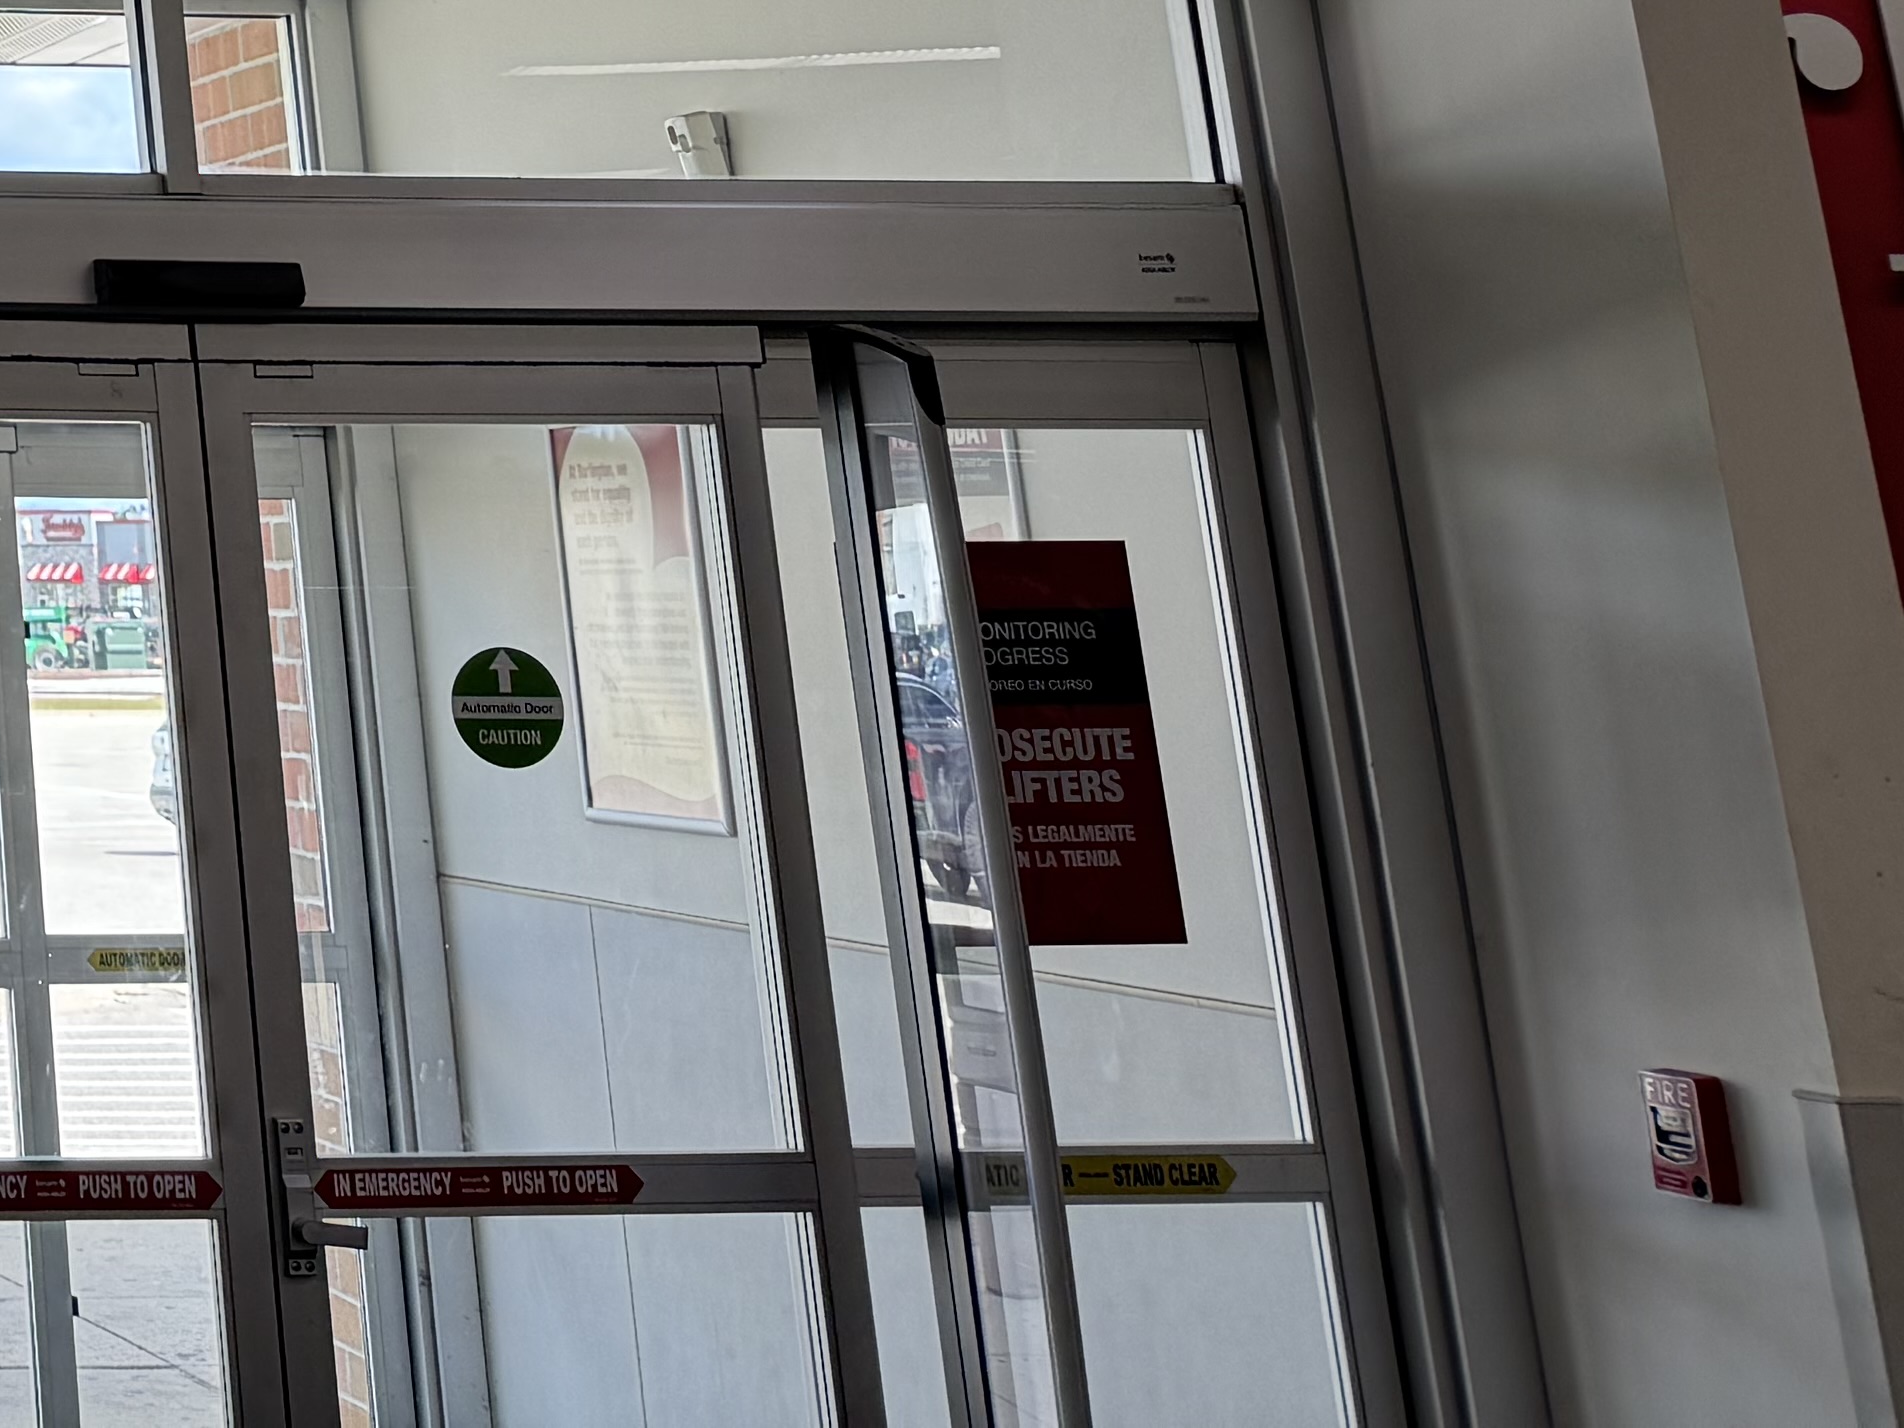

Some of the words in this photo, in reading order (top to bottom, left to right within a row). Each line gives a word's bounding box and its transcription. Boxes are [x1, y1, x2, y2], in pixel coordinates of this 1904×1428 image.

[1029, 679, 1044, 690] EN
[1049, 679, 1092, 690] CURSO
[461, 702, 521, 714] Automatic
[525, 703, 554, 714] Door
[479, 729, 541, 745] CAUTION
[1028, 824, 1136, 842] LEGALMENTE
[1035, 850, 1056, 868] LA
[1060, 849, 1122, 867] TIENDA
[99, 952, 156, 968] AUTOMATIC
[1644, 1077, 1691, 1108] FIRE
[333, 1172, 350, 1197] IN
[355, 1171, 452, 1196] EMERGENCY
[502, 1170, 545, 1194] PUSH
[549, 1170, 570, 1194] TO
[575, 1169, 618, 1193] OPEN
[1113, 1163, 1164, 1186] STAND
[1169, 1163, 1220, 1186] CLEAR
[80, 1175, 122, 1199] PUSH
[126, 1175, 148, 1199] TO
[153, 1175, 196, 1199] OPEN
